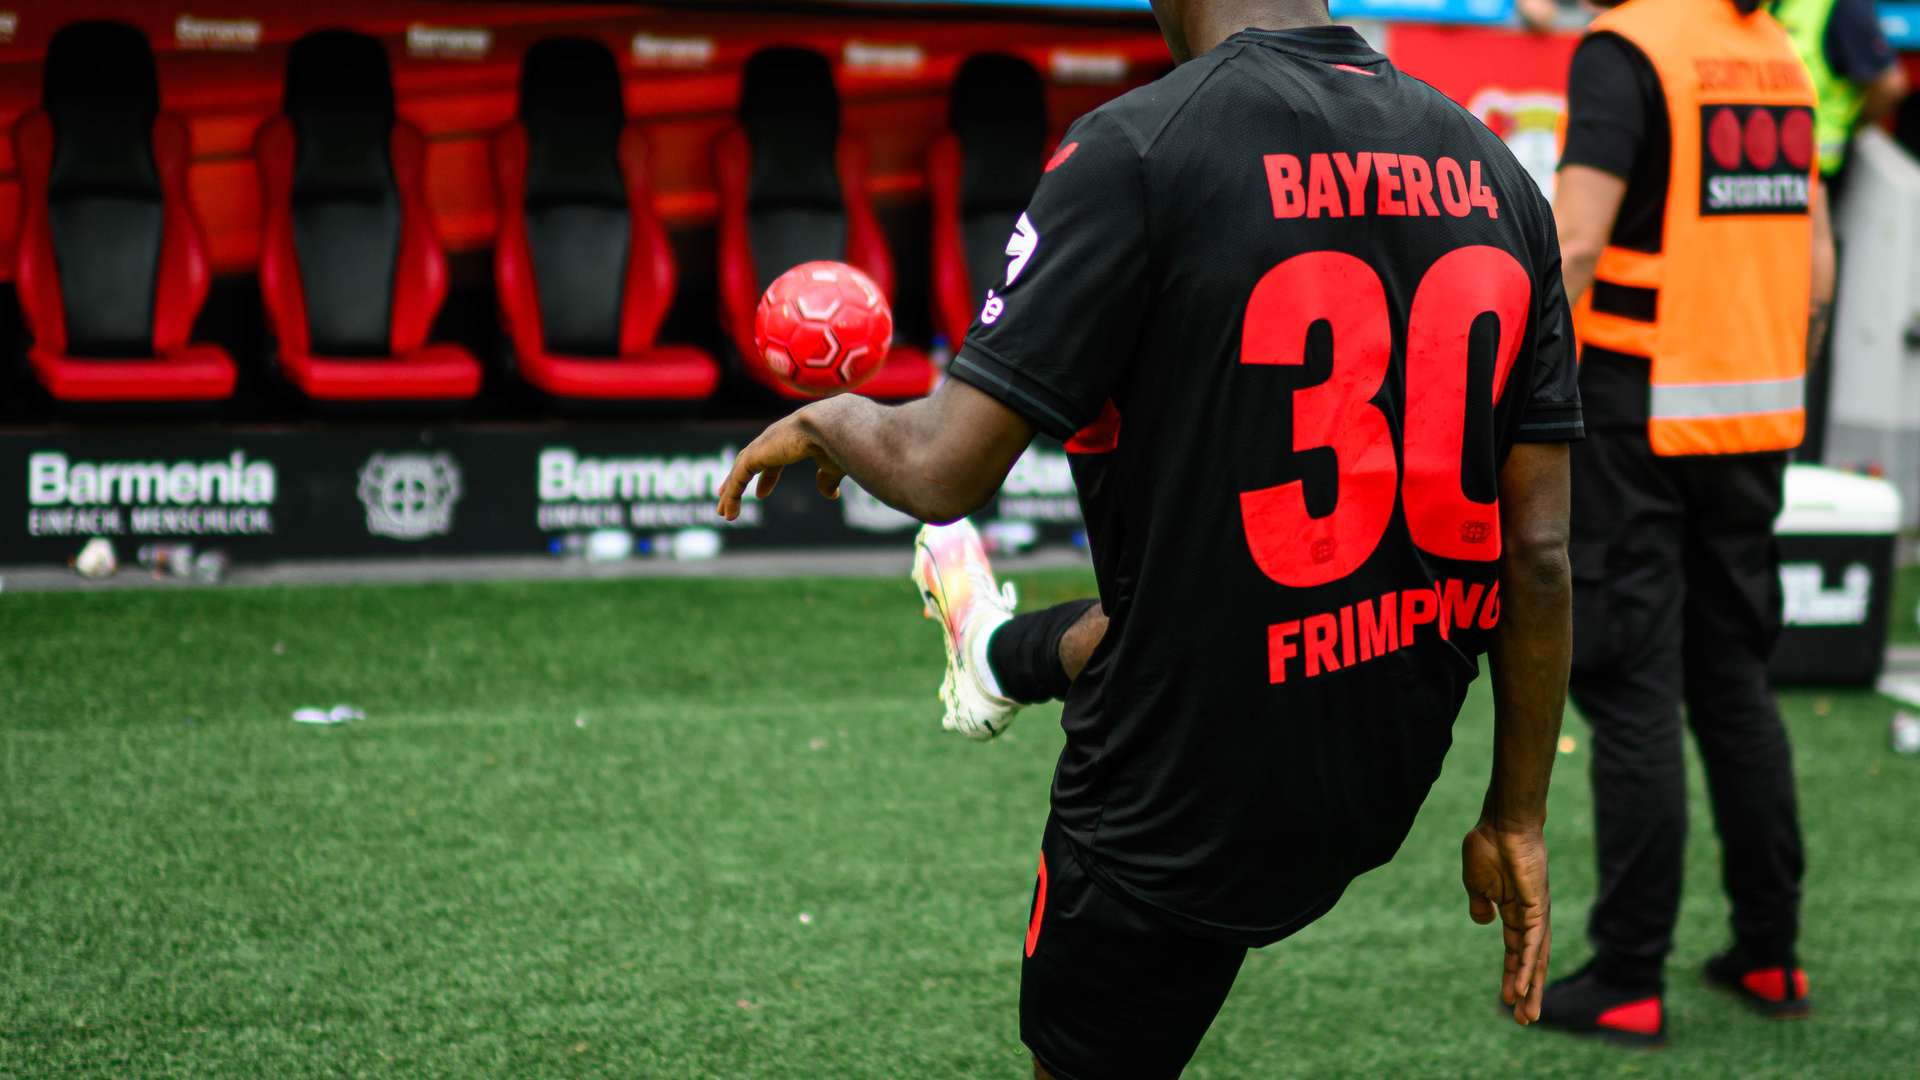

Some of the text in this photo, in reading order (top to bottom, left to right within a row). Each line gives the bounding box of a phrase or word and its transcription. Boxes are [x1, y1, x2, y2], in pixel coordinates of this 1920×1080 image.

[1239, 245, 1531, 589] 30
[29, 451, 275, 505] Barmenia
[538, 446, 759, 501] Barmeni
